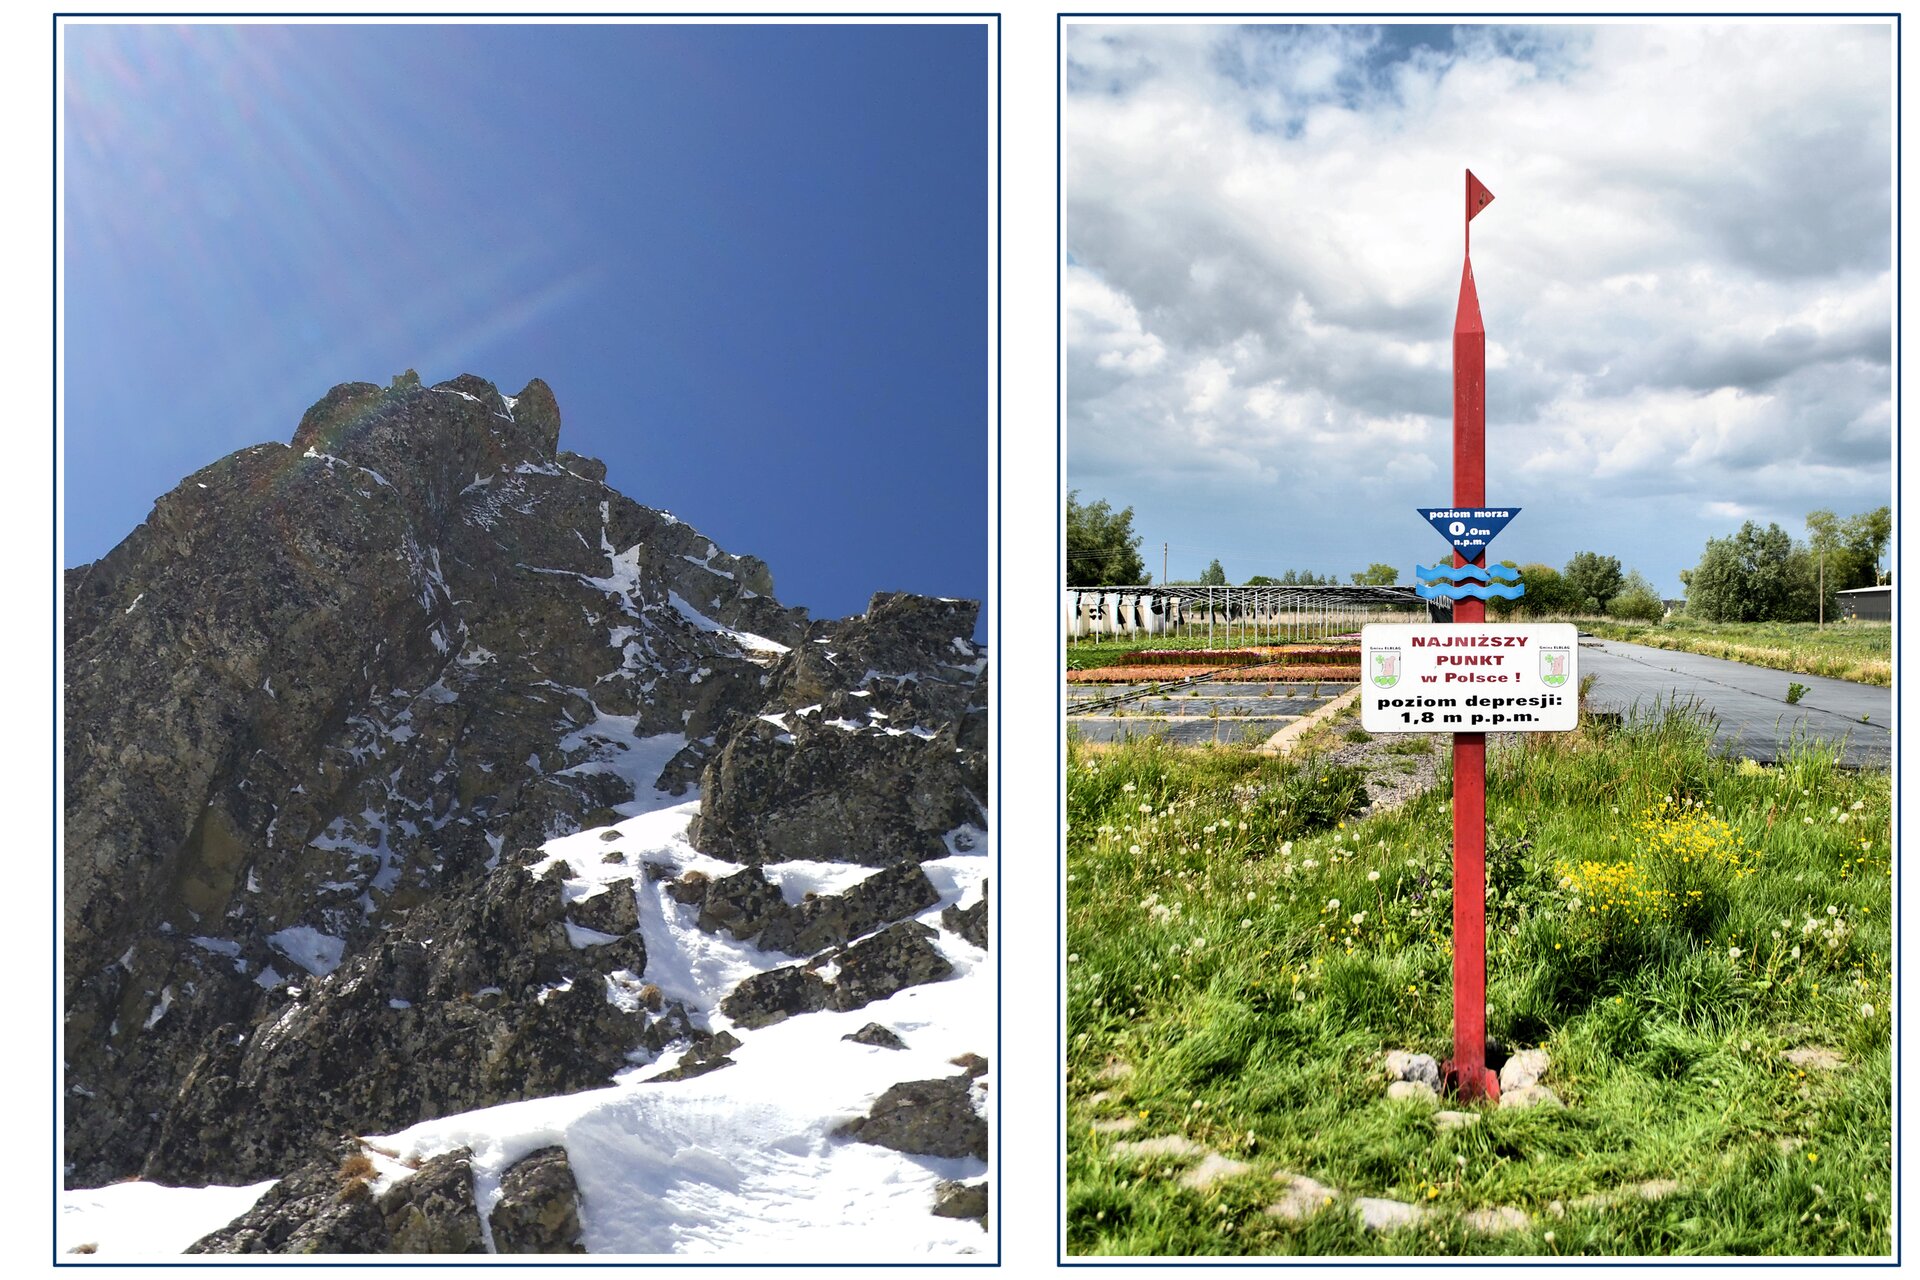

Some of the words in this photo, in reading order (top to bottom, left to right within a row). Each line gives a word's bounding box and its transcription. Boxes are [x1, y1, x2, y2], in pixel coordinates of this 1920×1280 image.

[1430, 509, 1470, 520] poziom
[1474, 510, 1509, 518] morza
[1453, 538, 1486, 547] n.p.m.
[1411, 633, 1529, 647] NAJNIŻSZY
[1436, 655, 1505, 666] PUNKT
[1421, 674, 1438, 683] w
[1445, 672, 1508, 683] Polsce
[1377, 696, 1457, 710] poziom
[1465, 694, 1562, 709] depresji:
[1401, 711, 1434, 725] 1,8
[1443, 713, 1462, 723] m
[1471, 712, 1540, 725] p.p.m.
